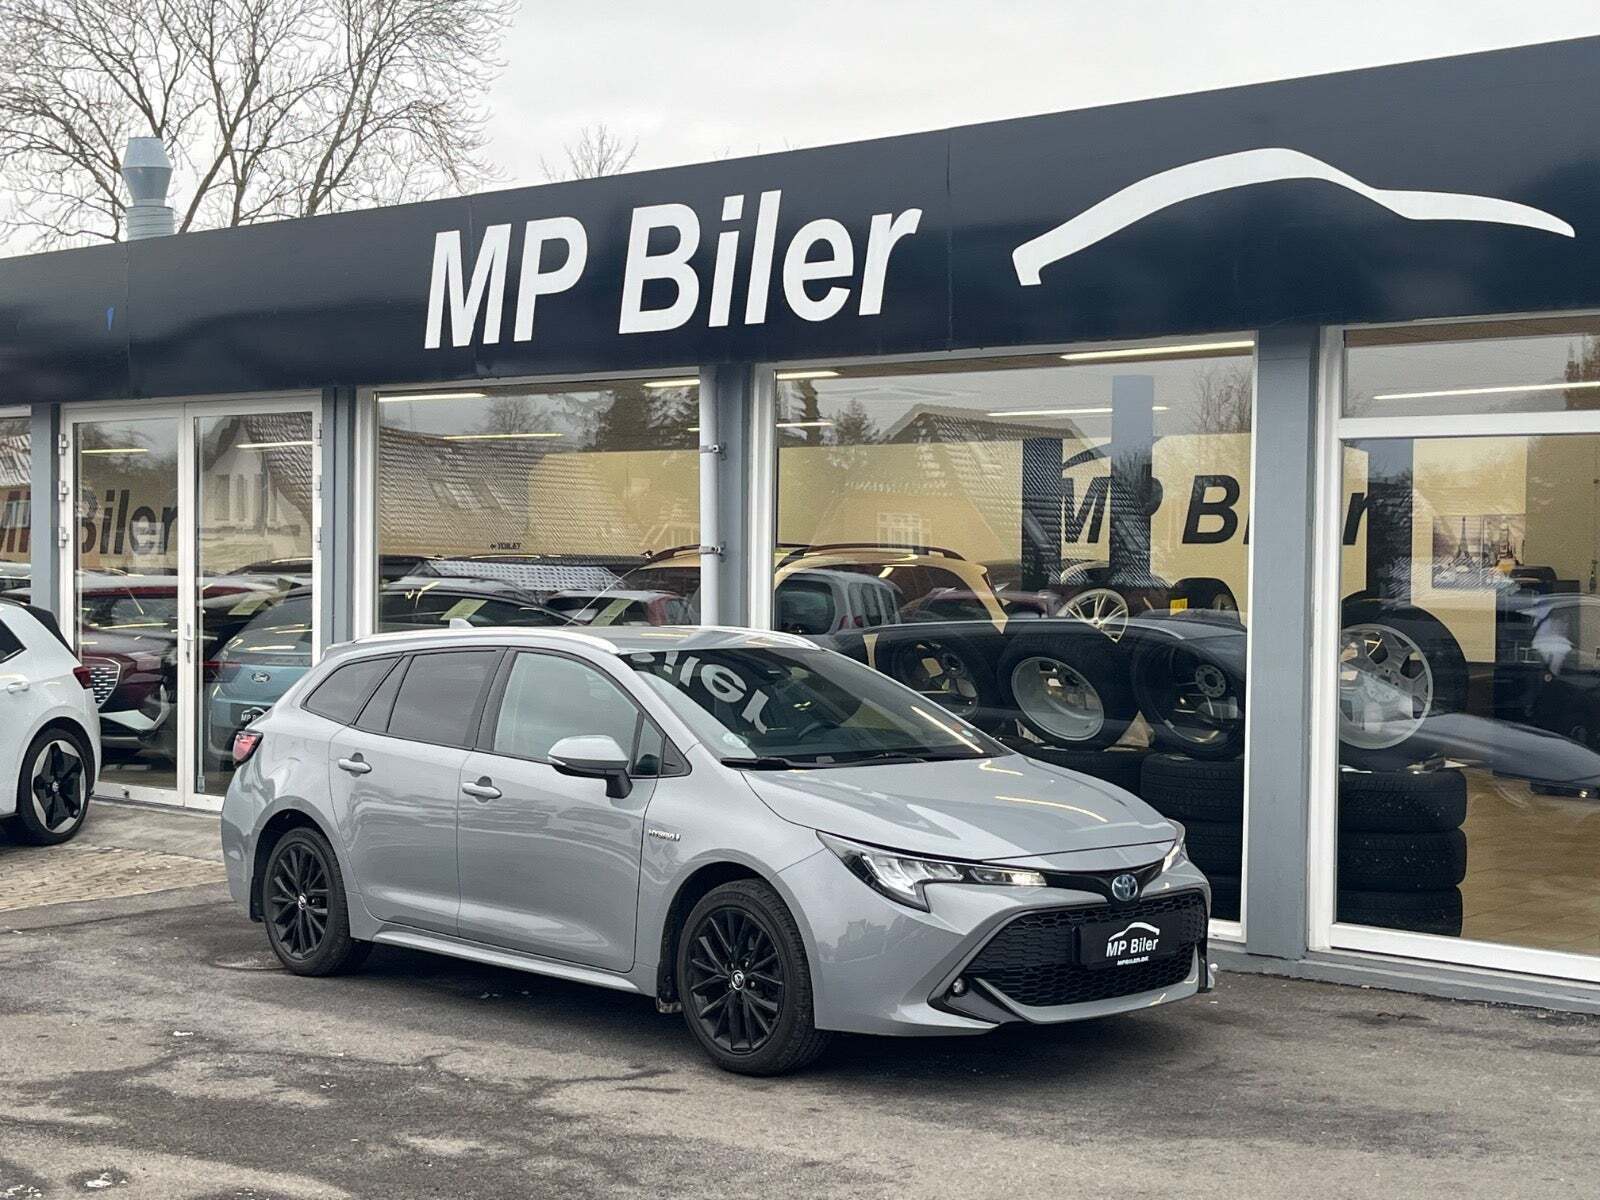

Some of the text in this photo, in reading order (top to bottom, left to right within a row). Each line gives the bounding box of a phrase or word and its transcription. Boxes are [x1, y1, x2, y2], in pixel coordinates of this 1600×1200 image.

[424, 190, 923, 349] MP Biler
[1106, 937, 1159, 957] MP Biler
